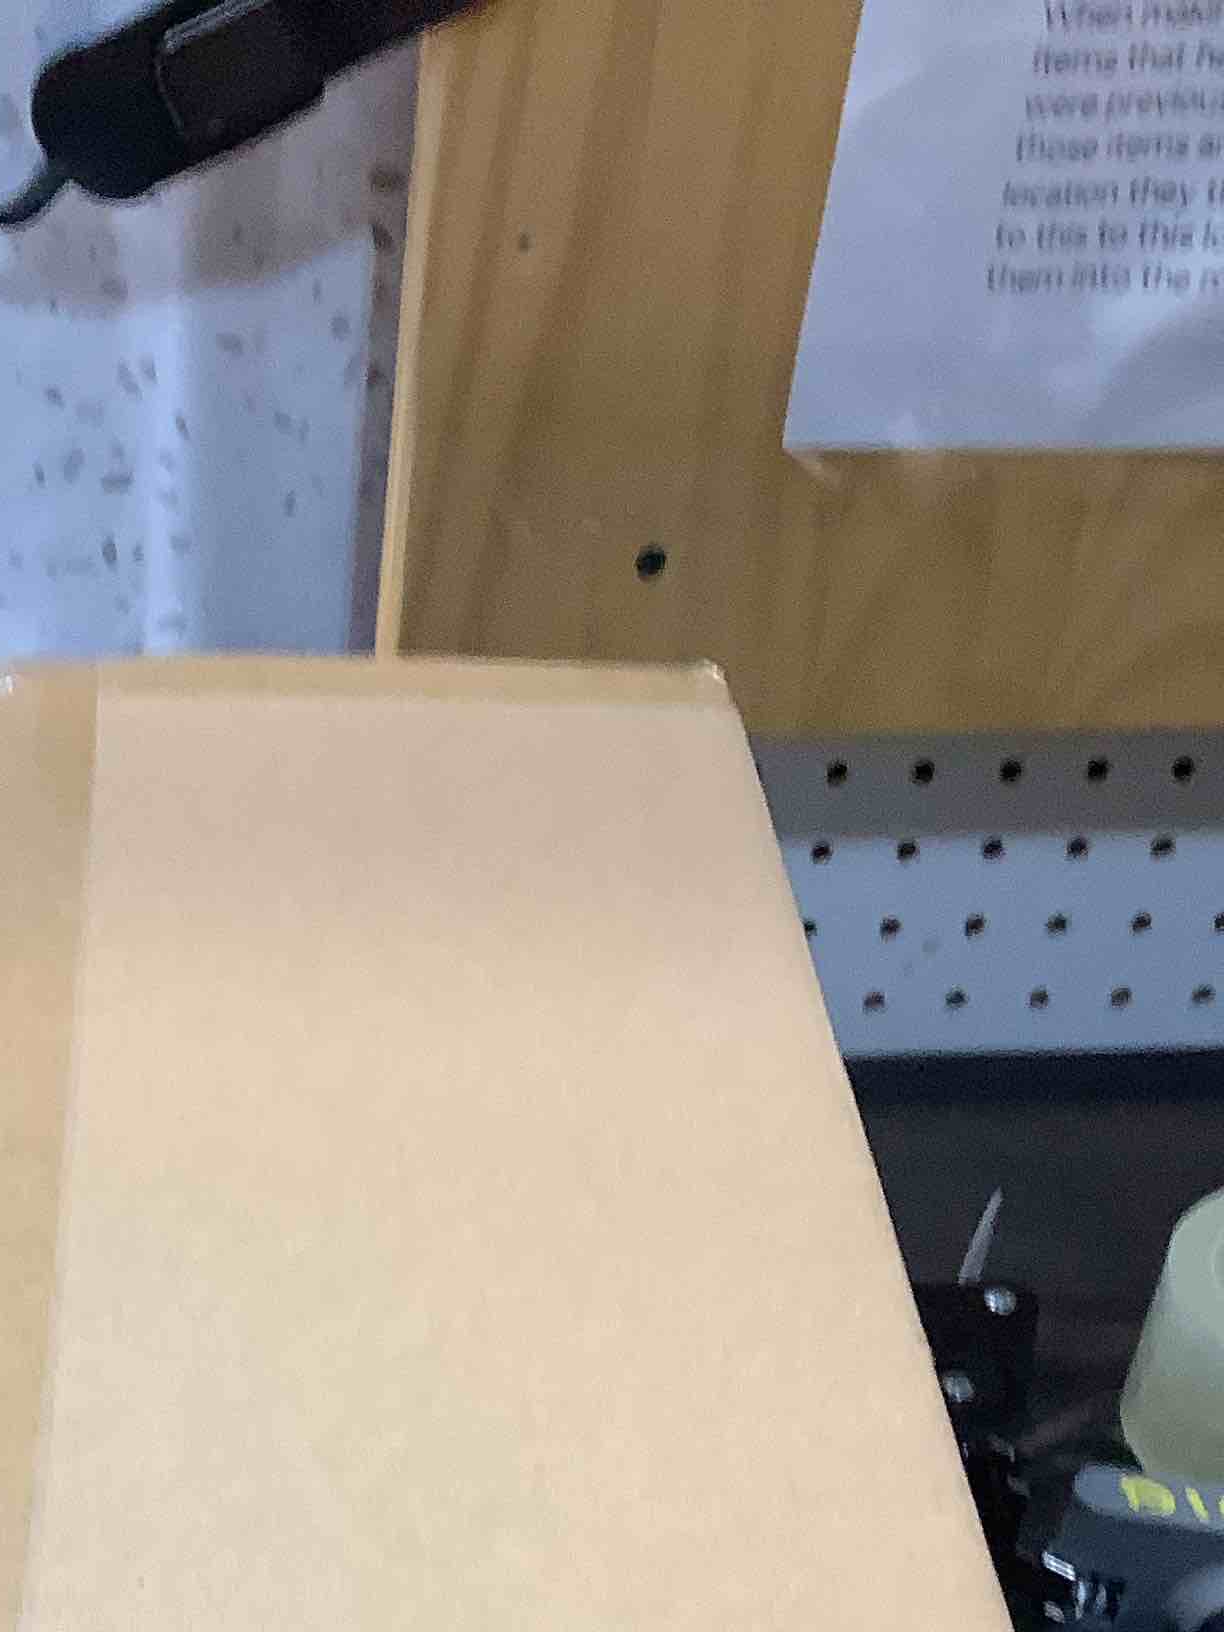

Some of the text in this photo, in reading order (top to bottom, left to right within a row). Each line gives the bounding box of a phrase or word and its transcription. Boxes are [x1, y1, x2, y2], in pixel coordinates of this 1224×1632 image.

[1002, 178, 1119, 207] location
[995, 222, 1026, 249] to
[1098, 220, 1129, 249] to
